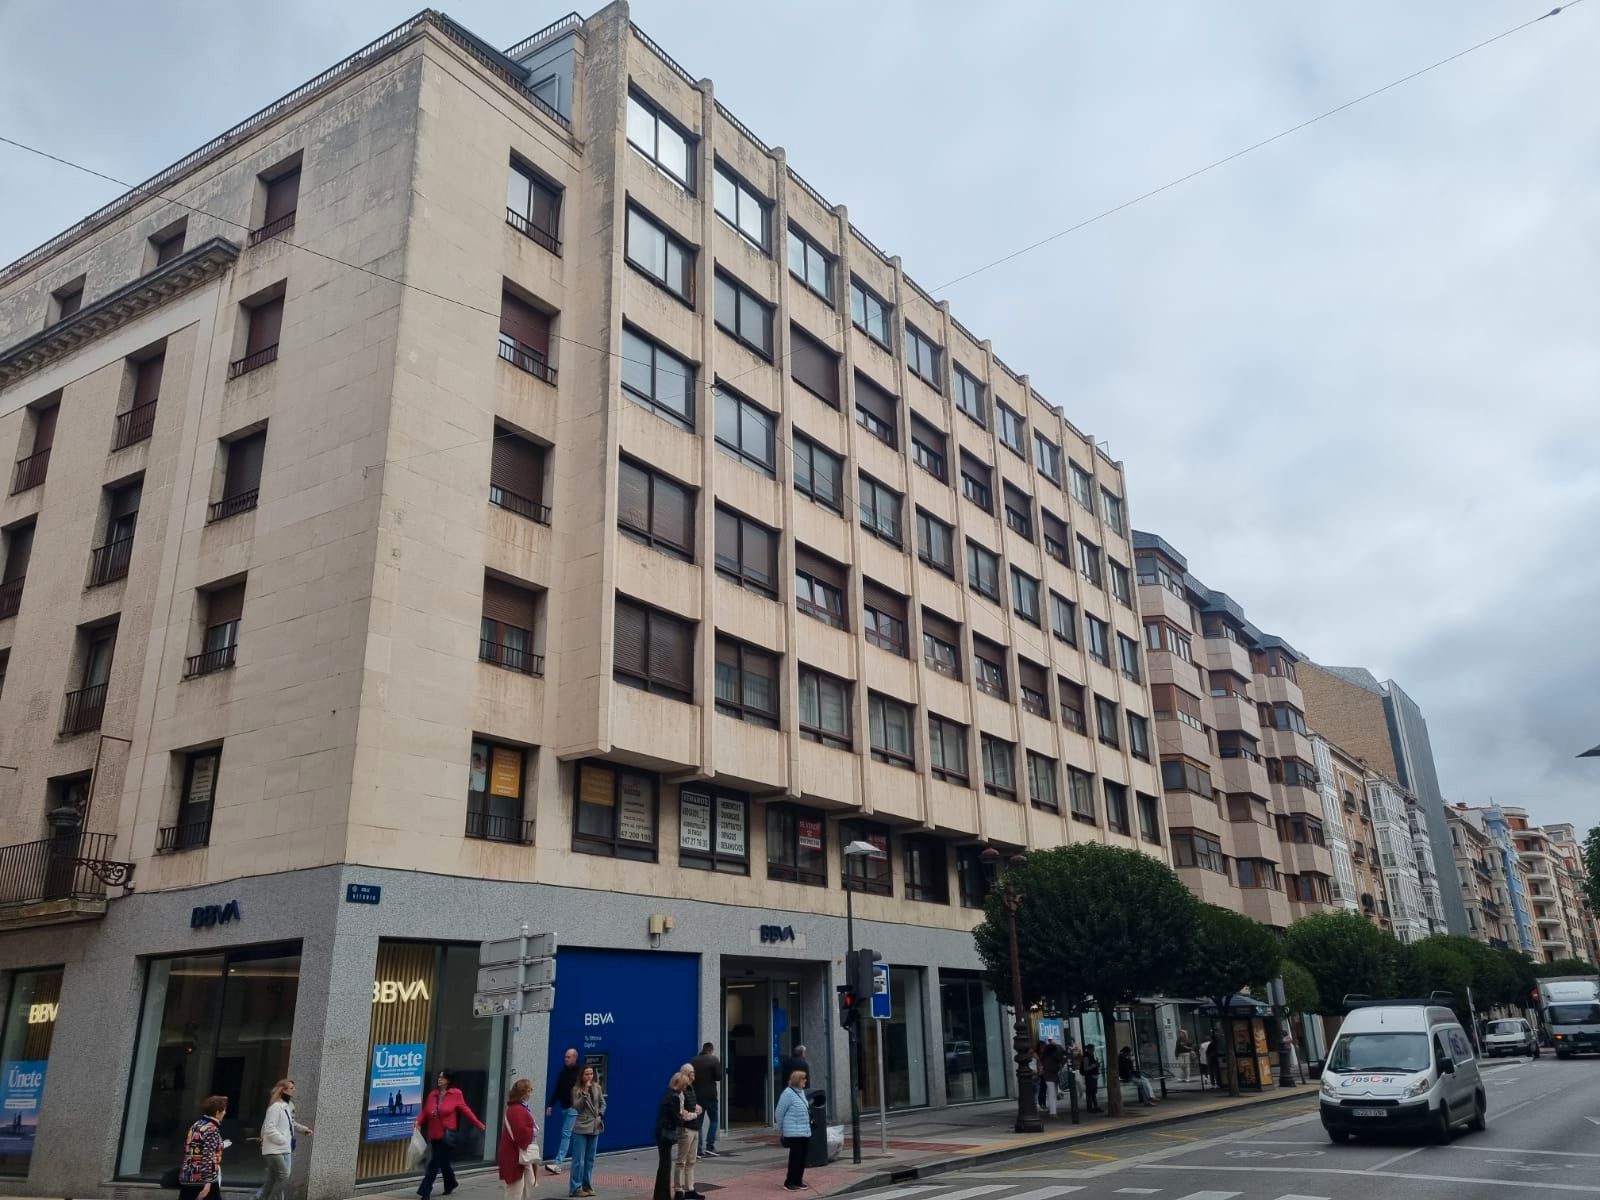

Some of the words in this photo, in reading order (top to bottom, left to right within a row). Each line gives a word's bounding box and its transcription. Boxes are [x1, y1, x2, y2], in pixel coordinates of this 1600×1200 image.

[191, 900, 240, 928] BBVA
[760, 925, 795, 944] BBVA
[28, 1003, 59, 1024] BBV
[584, 1011, 614, 1026] BBVA
[375, 1047, 423, 1068] Únete
[8, 1066, 42, 1088] Únete
